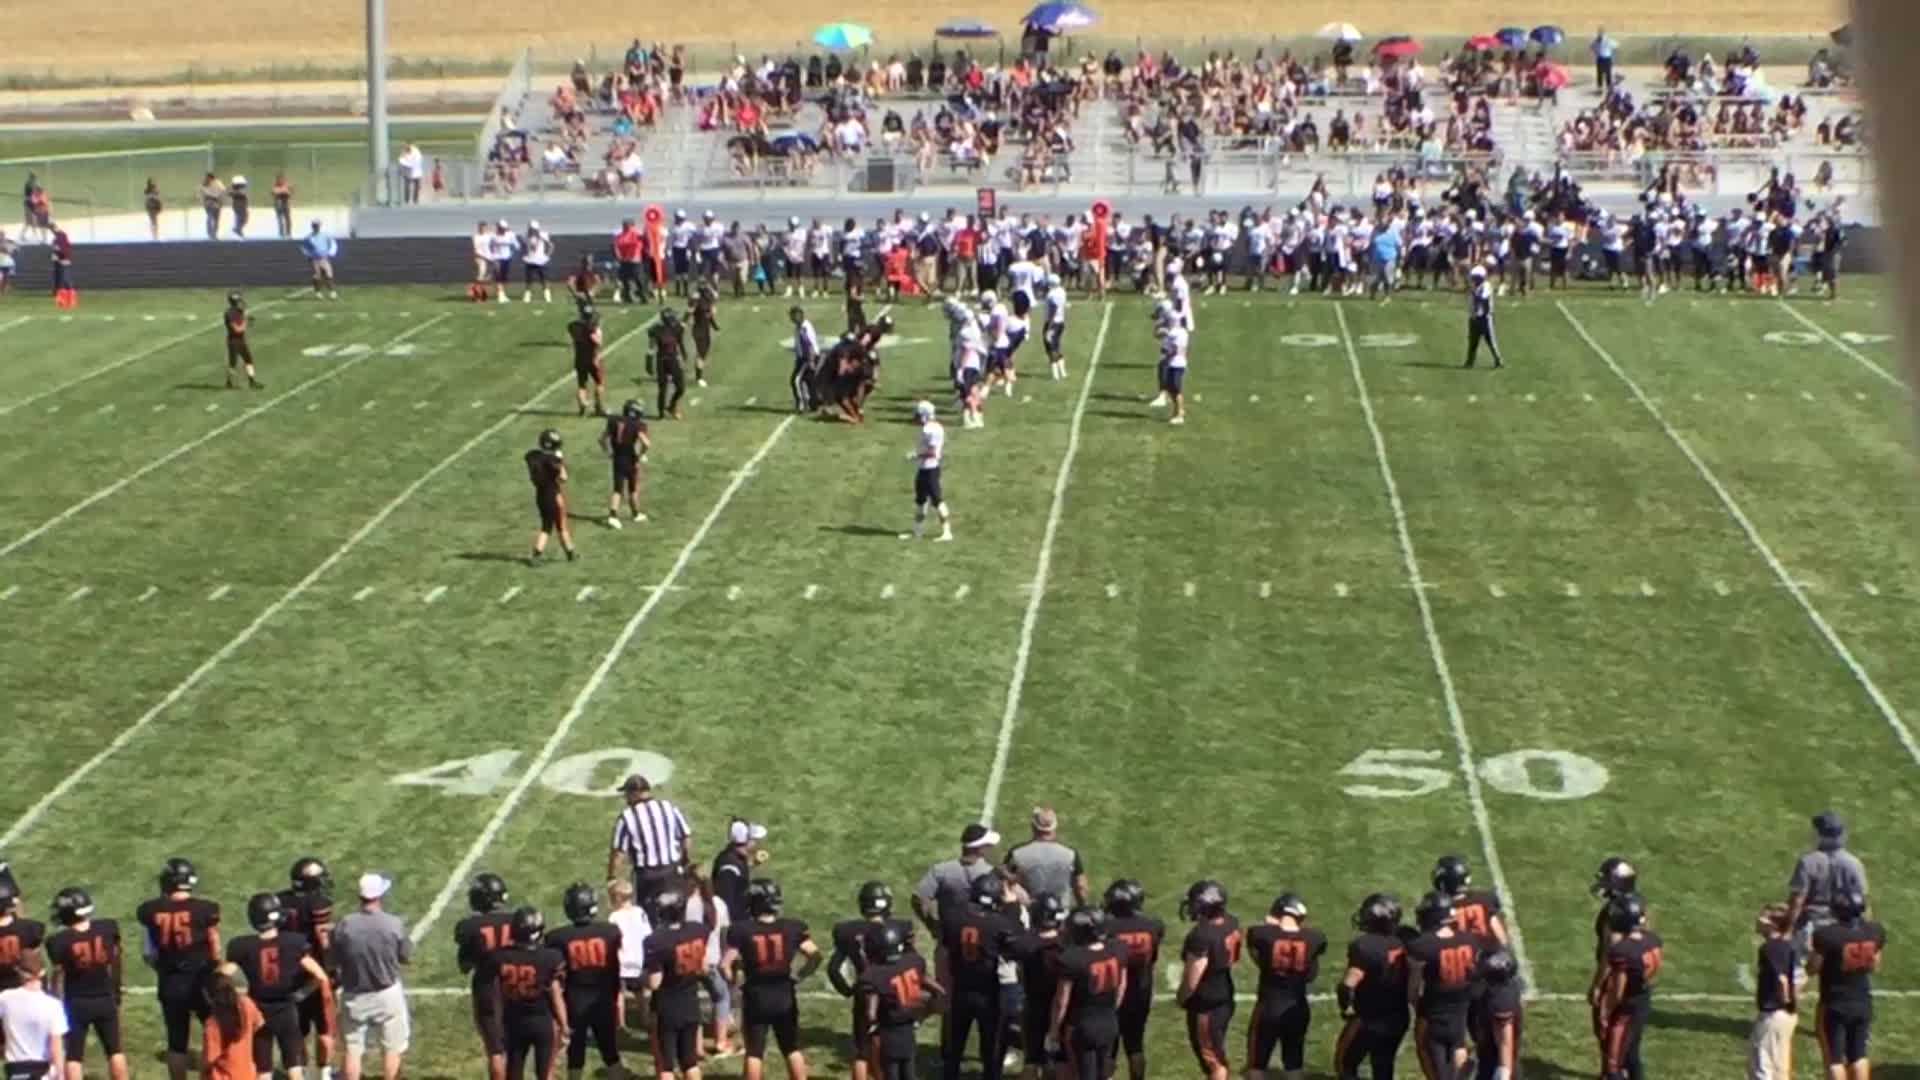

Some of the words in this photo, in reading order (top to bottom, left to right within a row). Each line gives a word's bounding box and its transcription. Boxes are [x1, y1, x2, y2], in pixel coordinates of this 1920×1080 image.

[386, 747, 675, 798] 40
[1335, 748, 1610, 799] 50
[752, 933, 785, 968] 11
